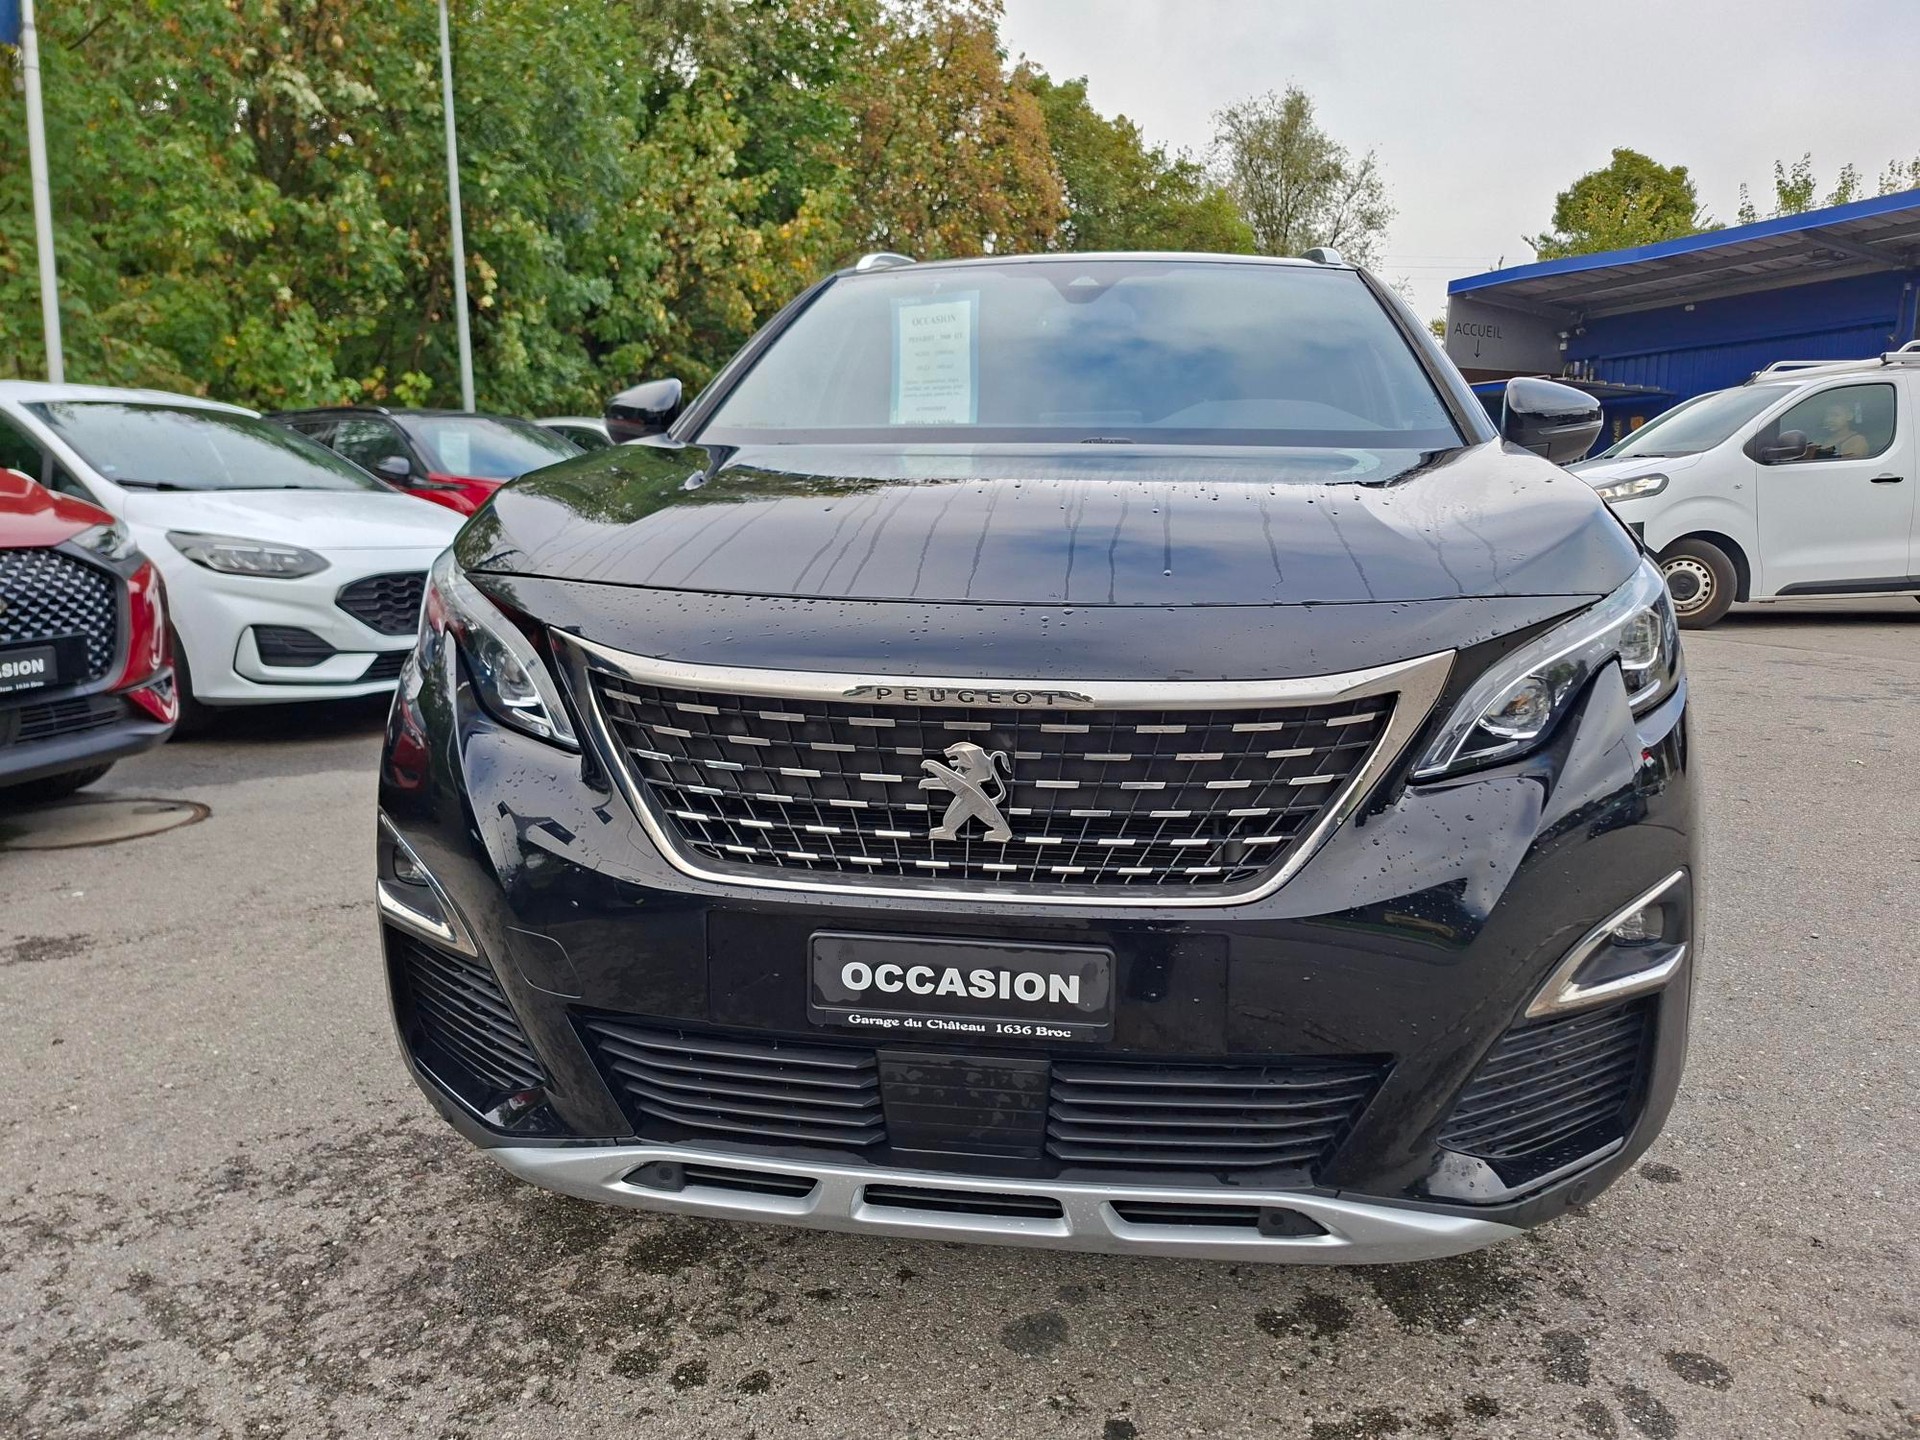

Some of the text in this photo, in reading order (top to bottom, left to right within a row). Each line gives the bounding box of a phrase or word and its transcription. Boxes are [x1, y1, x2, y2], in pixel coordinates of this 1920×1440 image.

[912, 314, 957, 326] OCCASION
[1454, 322, 1502, 339] ACCUEIL
[876, 687, 1059, 705] PEUGEOT
[841, 961, 1080, 1004] OCCASION
[848, 1014, 1071, 1038] Garage du Château 1636 Broc
